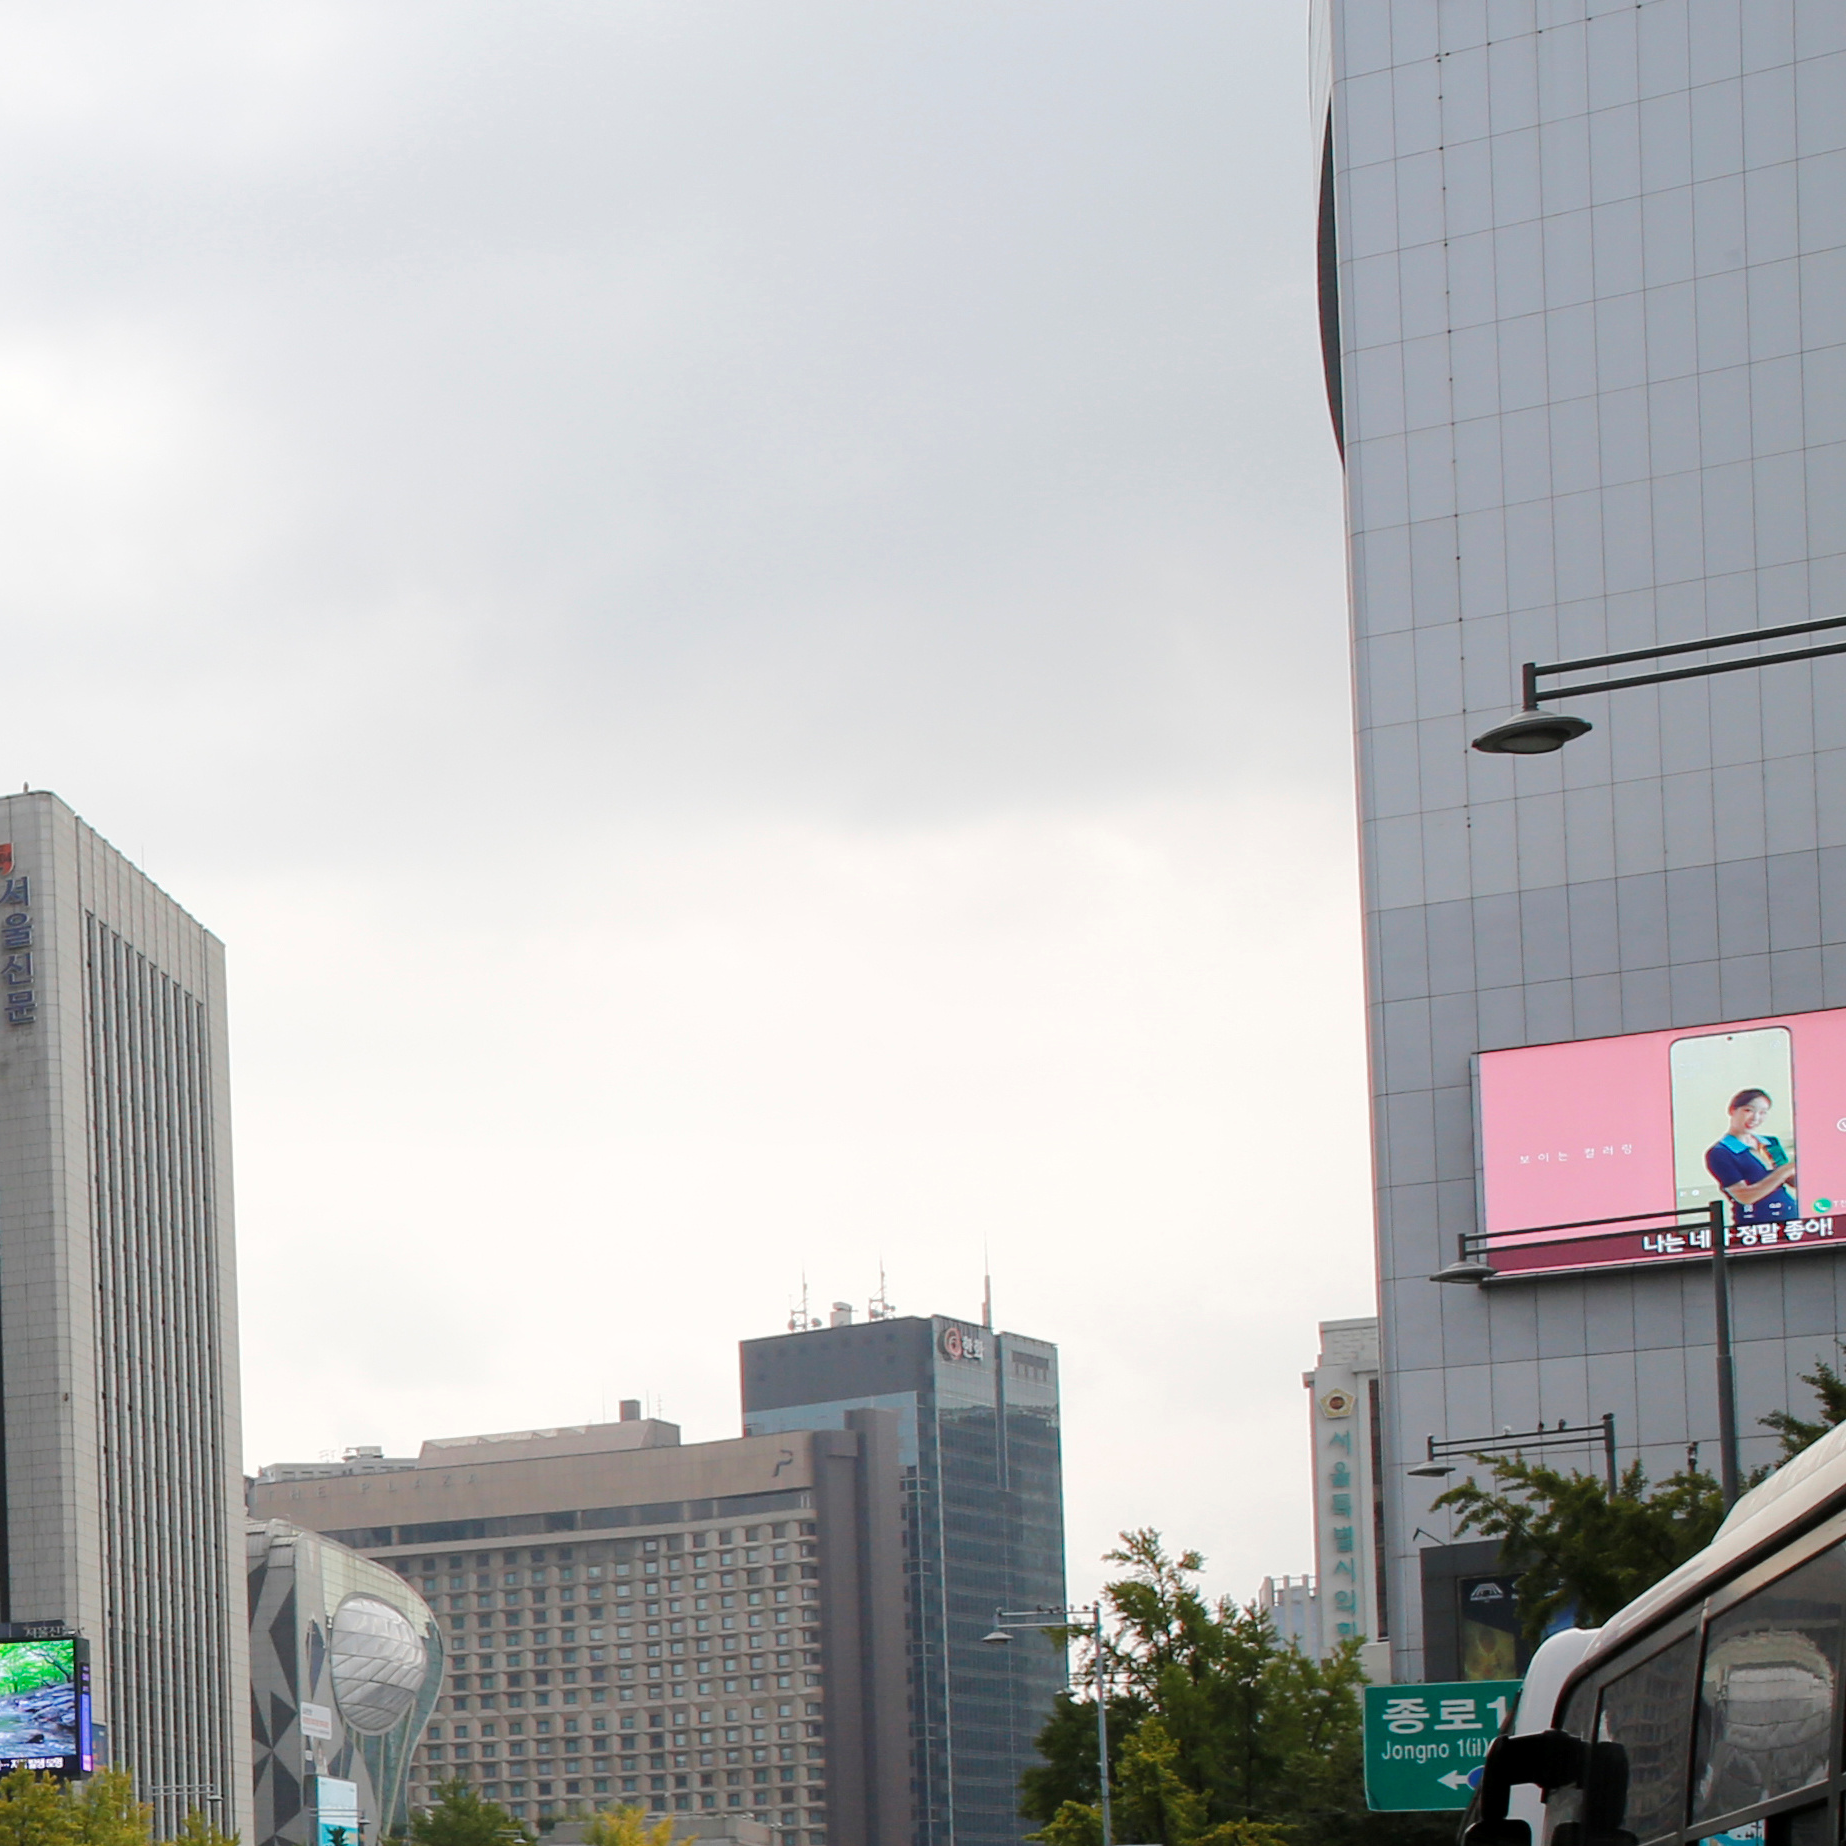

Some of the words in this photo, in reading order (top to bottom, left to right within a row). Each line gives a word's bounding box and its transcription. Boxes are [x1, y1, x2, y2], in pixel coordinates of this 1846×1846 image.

[0, 875, 37, 1025] 서울신문
[1642, 1232, 1685, 1253] 나는
[1736, 1222, 1780, 1246] 정말
[1784, 1217, 1834, 1242] 좋아!
[361, 1473, 477, 1494] PLAZA
[1382, 1695, 1507, 1734] 종로1
[1381, 1740, 1450, 1764] Jongno
